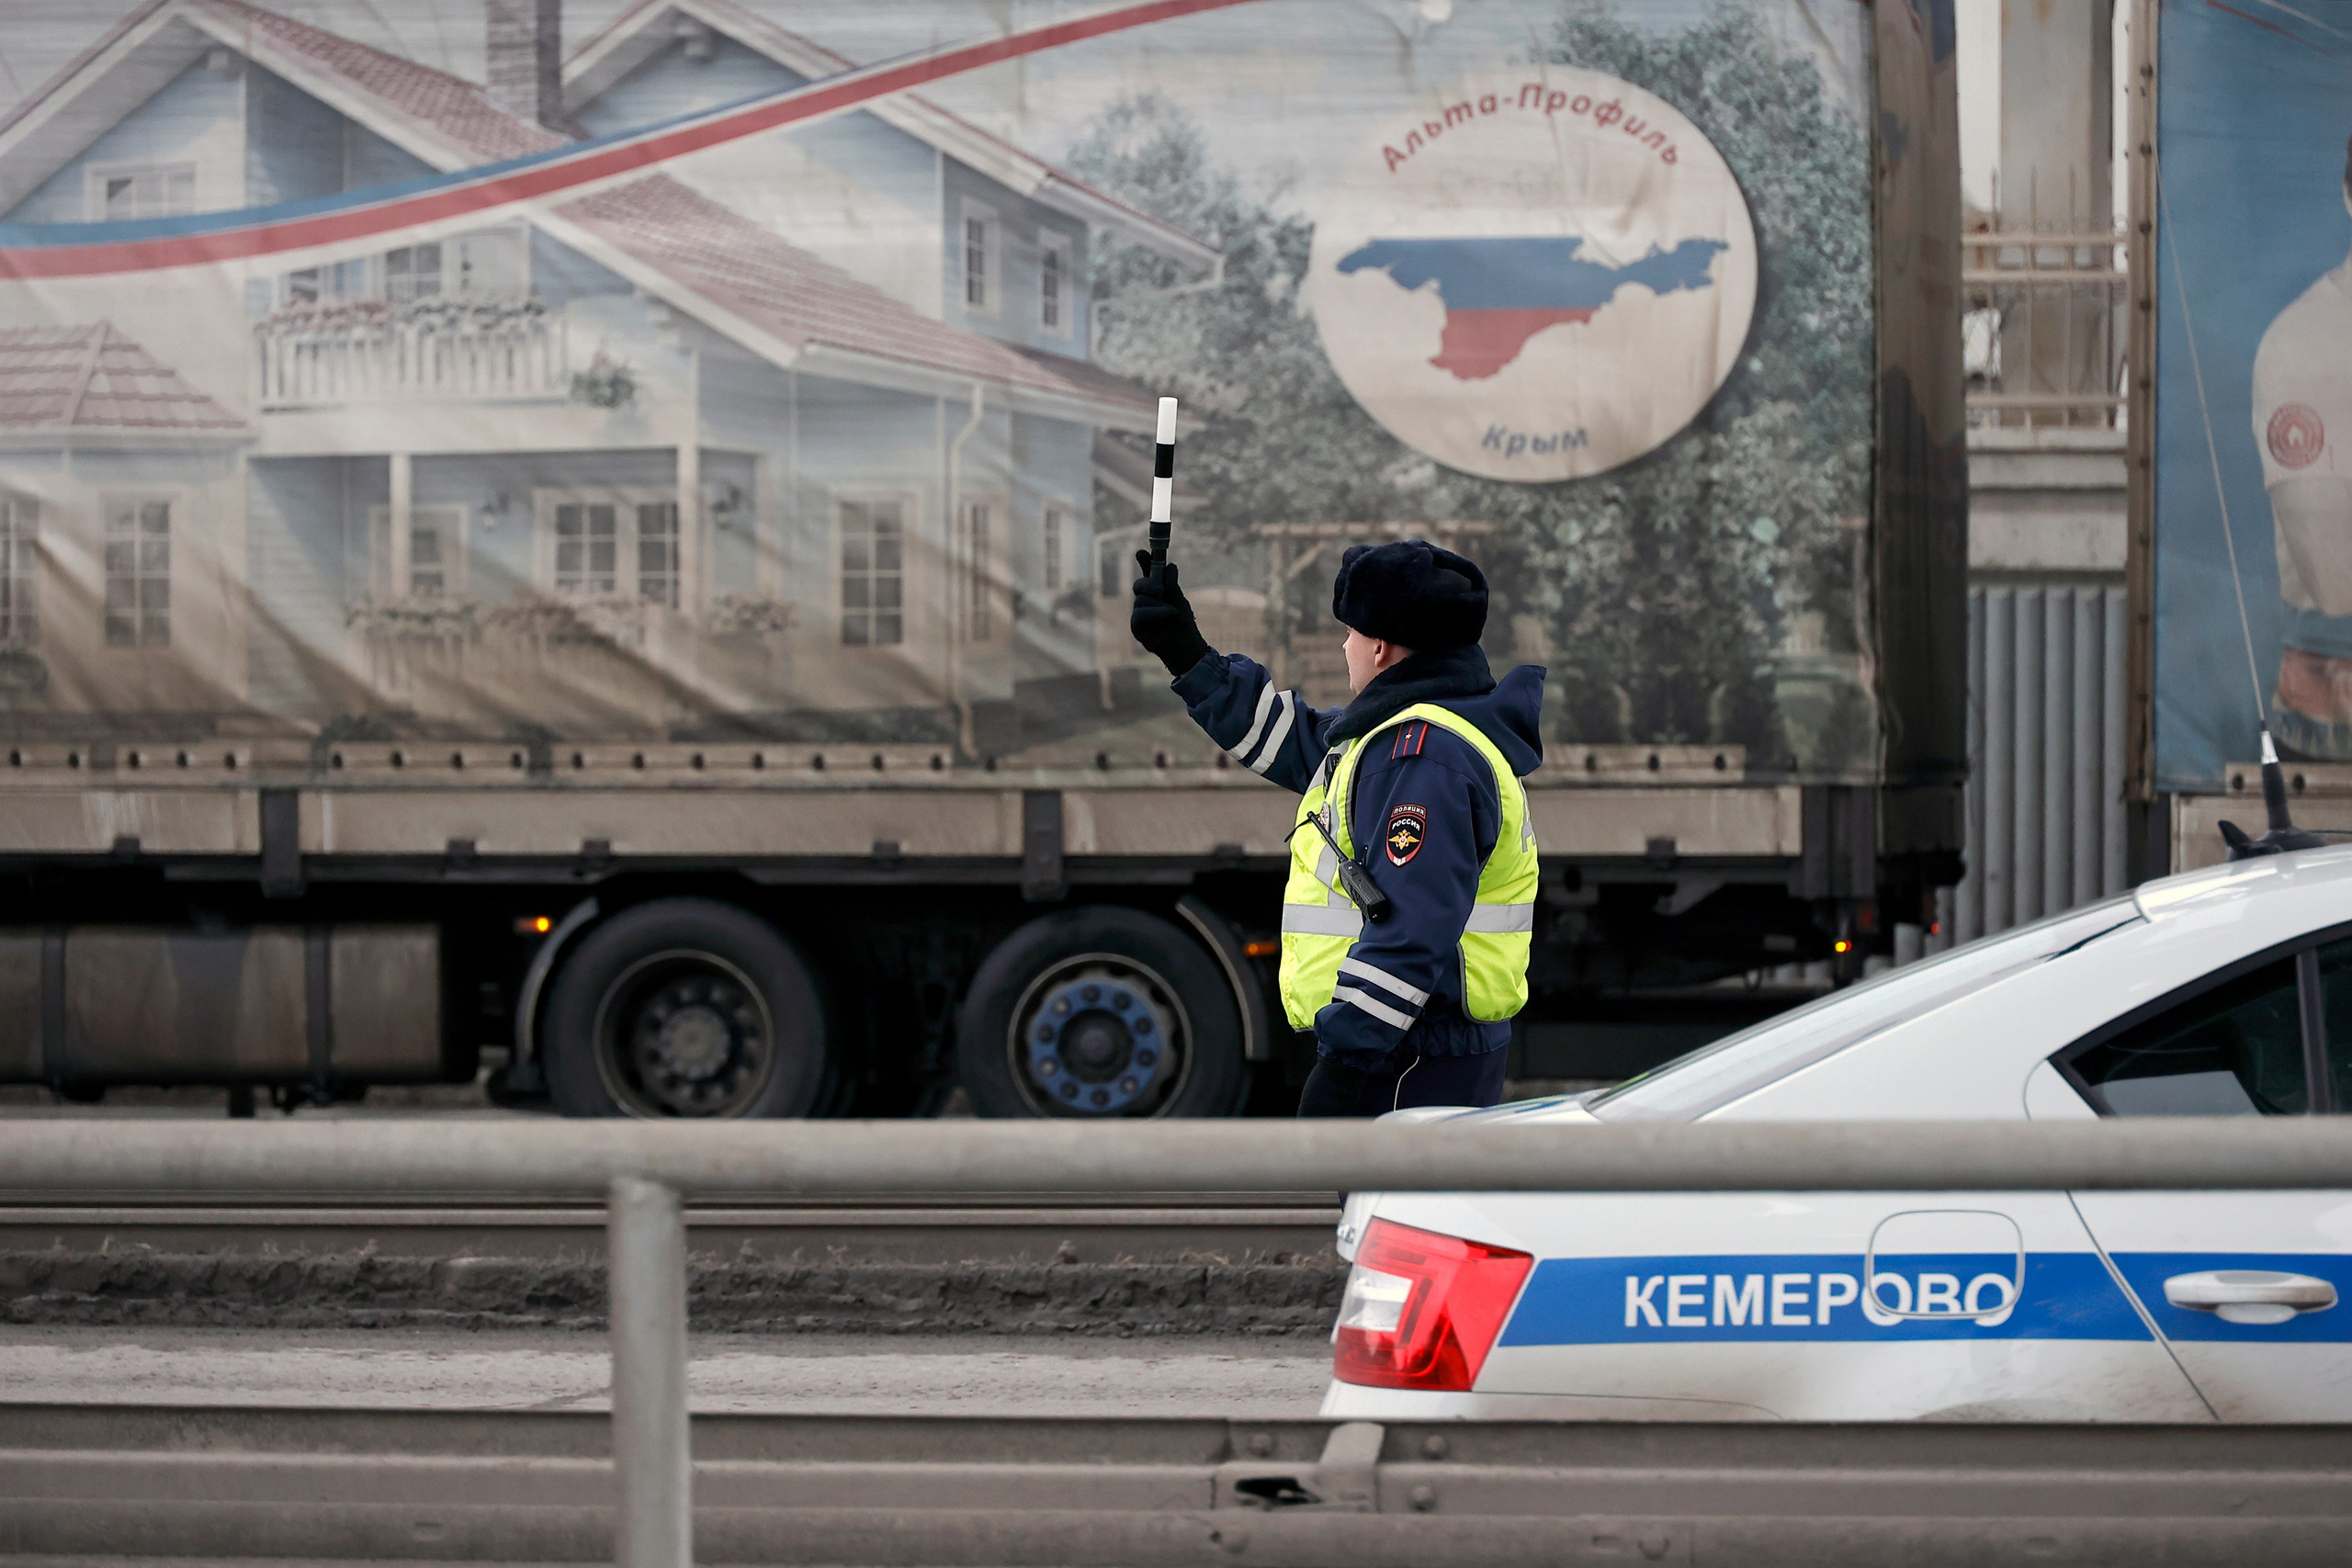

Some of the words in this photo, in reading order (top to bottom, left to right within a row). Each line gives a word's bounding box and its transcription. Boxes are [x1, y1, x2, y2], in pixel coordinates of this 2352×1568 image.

[1382, 84, 1678, 172] Альта-Профиль
[1482, 424, 1589, 457] Крым
[1392, 818, 1420, 831] РОССИЯ
[1394, 806, 1424, 815] ПОЛИЦИЯ
[1624, 1272, 2018, 1326] КЕМЕРОВО
